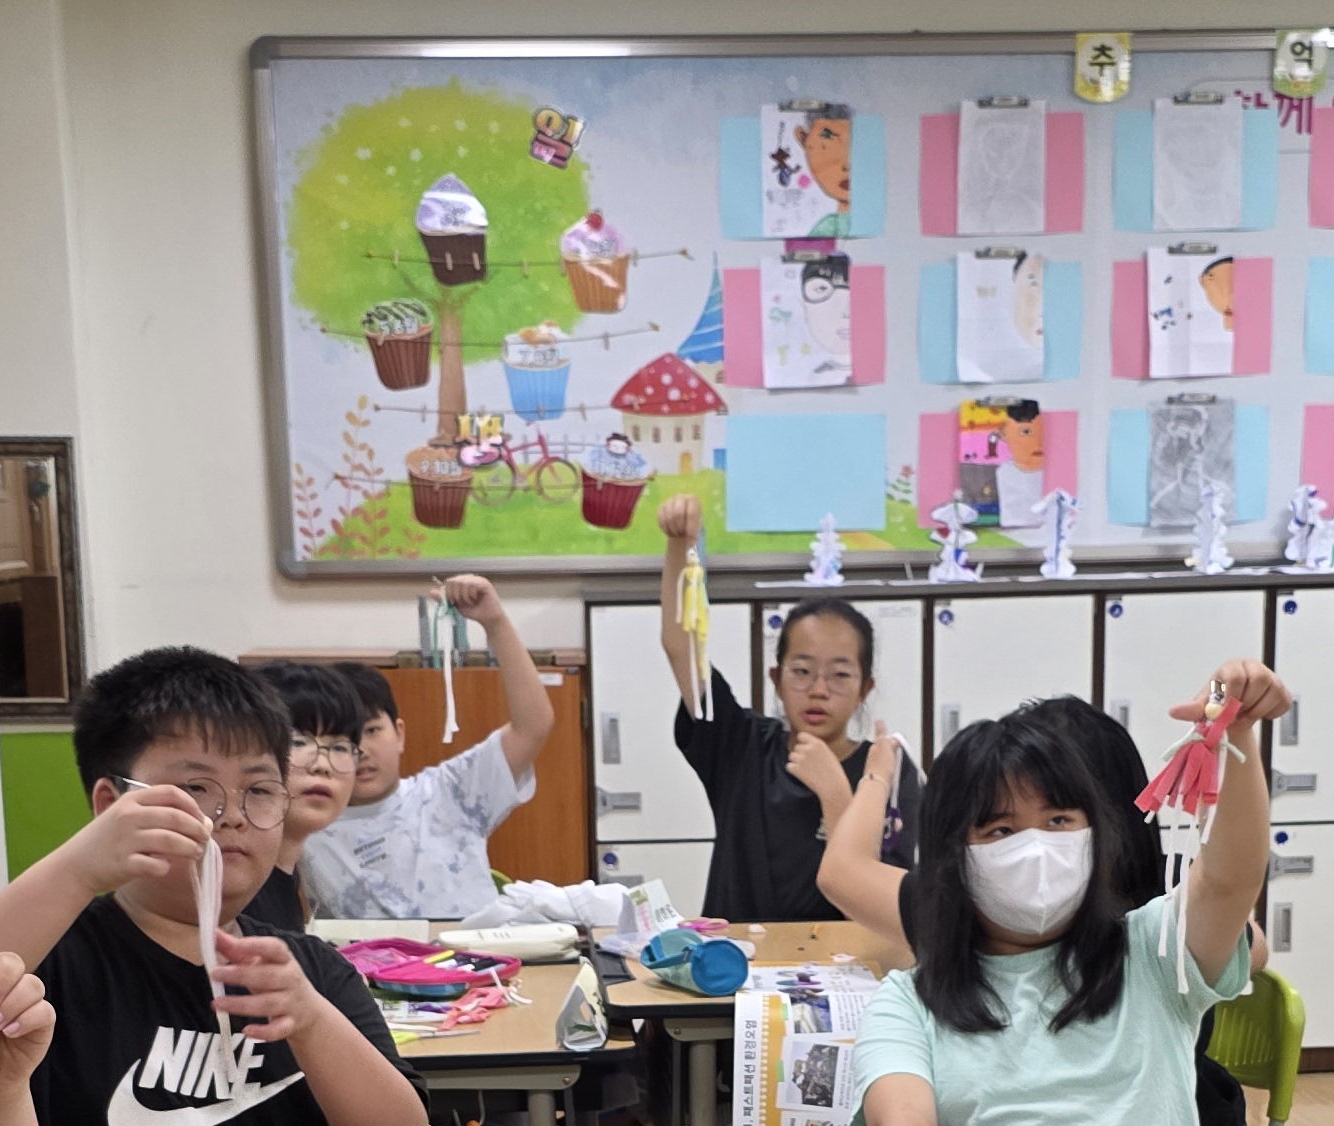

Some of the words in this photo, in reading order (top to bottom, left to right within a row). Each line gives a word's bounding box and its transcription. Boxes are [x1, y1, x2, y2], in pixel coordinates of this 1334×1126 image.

[1088, 44, 1117, 77] 추
[1290, 40, 1314, 69] 억
[139, 1026, 267, 1100] NIKE
[742, 1063, 757, 1118] 패스트패션
